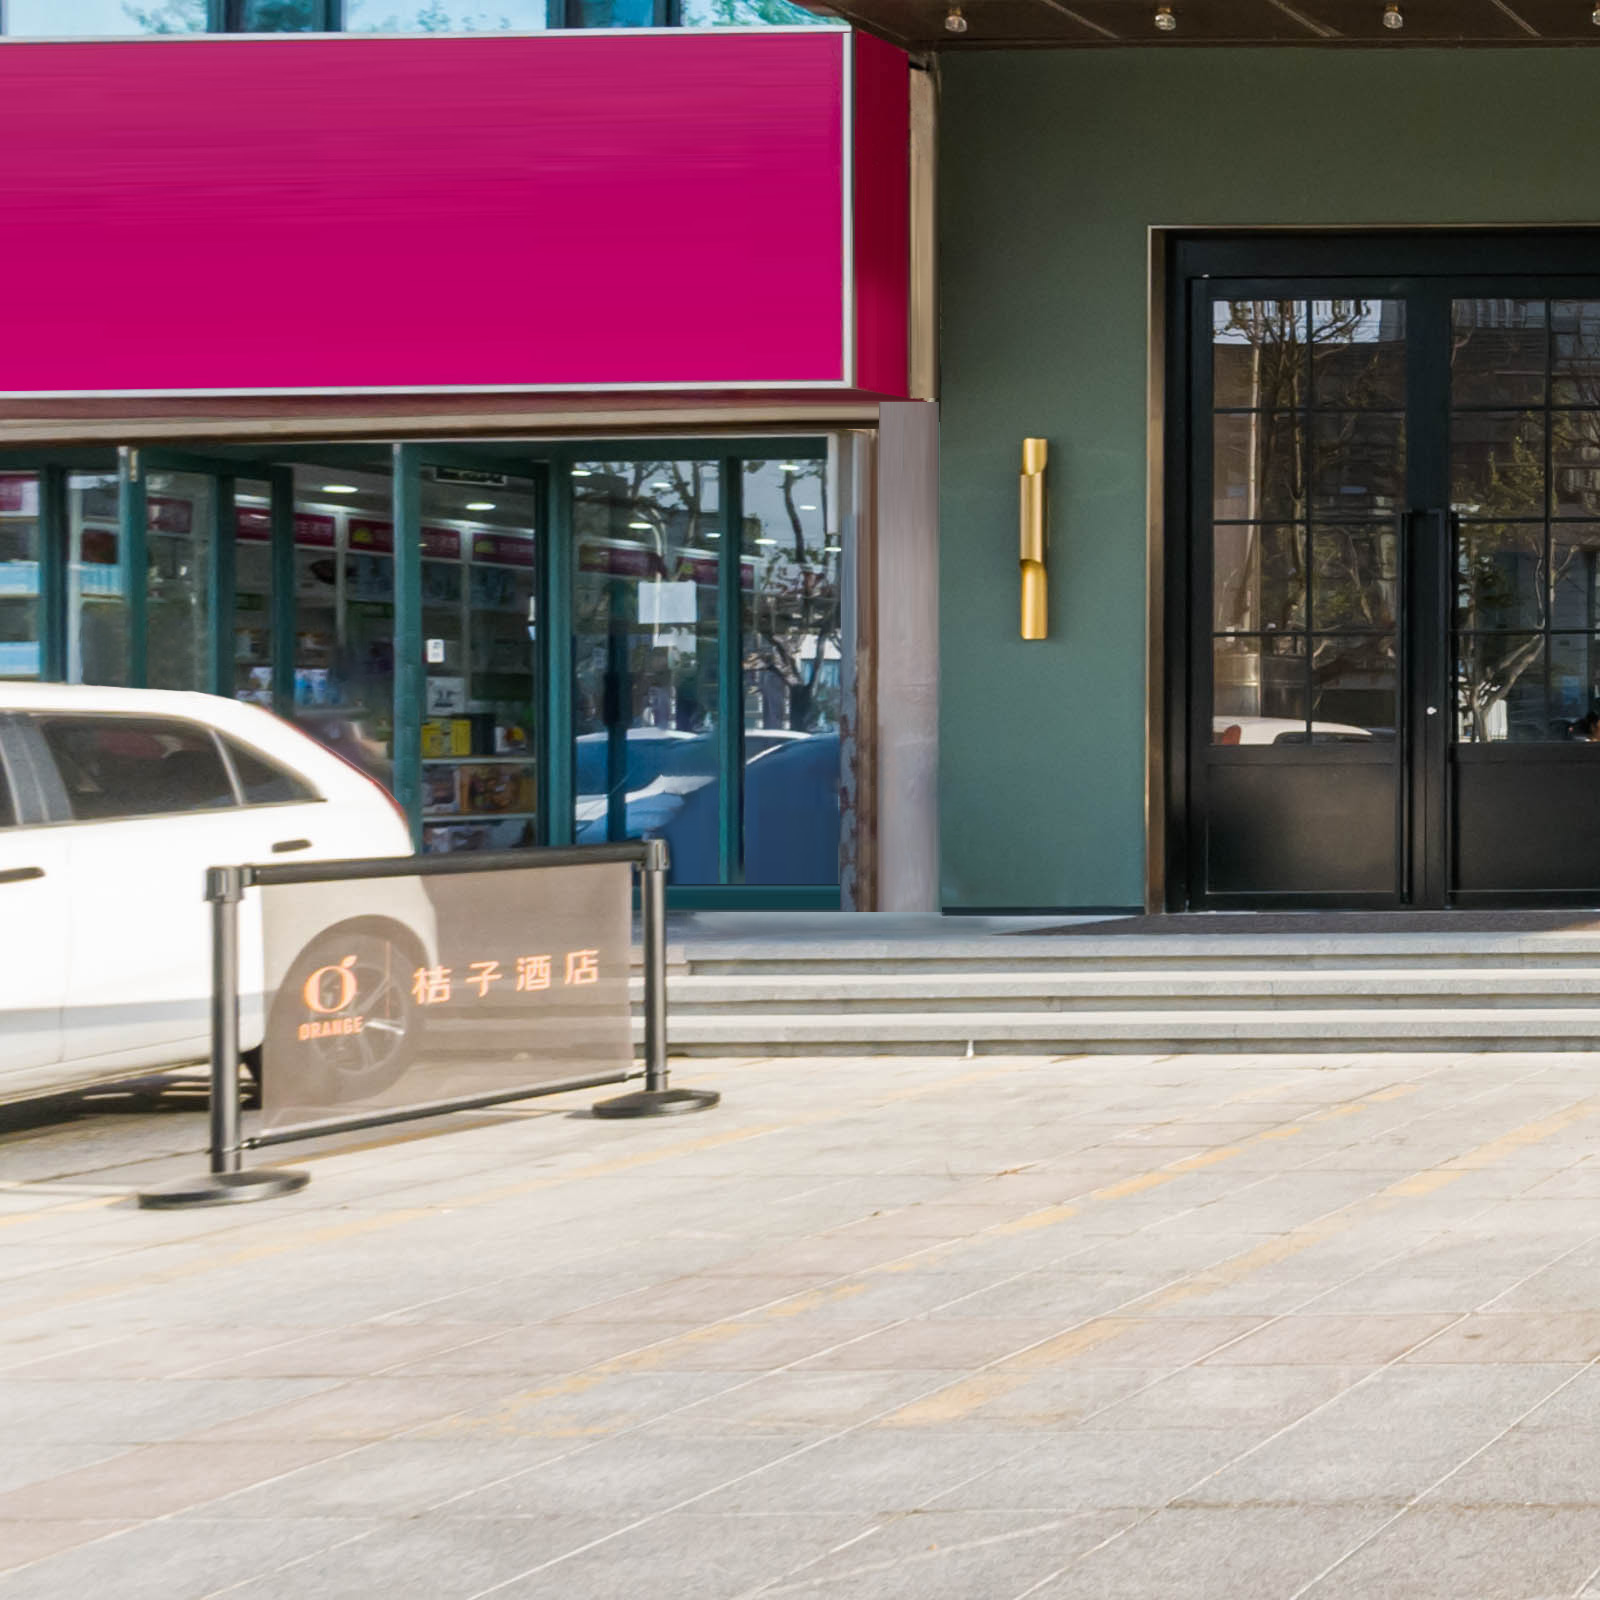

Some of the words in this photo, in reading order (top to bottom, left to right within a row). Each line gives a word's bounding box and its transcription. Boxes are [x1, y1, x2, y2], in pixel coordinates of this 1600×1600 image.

[411, 949, 599, 1005] 桔子酒店
[299, 1015, 364, 1041] ORANGE
